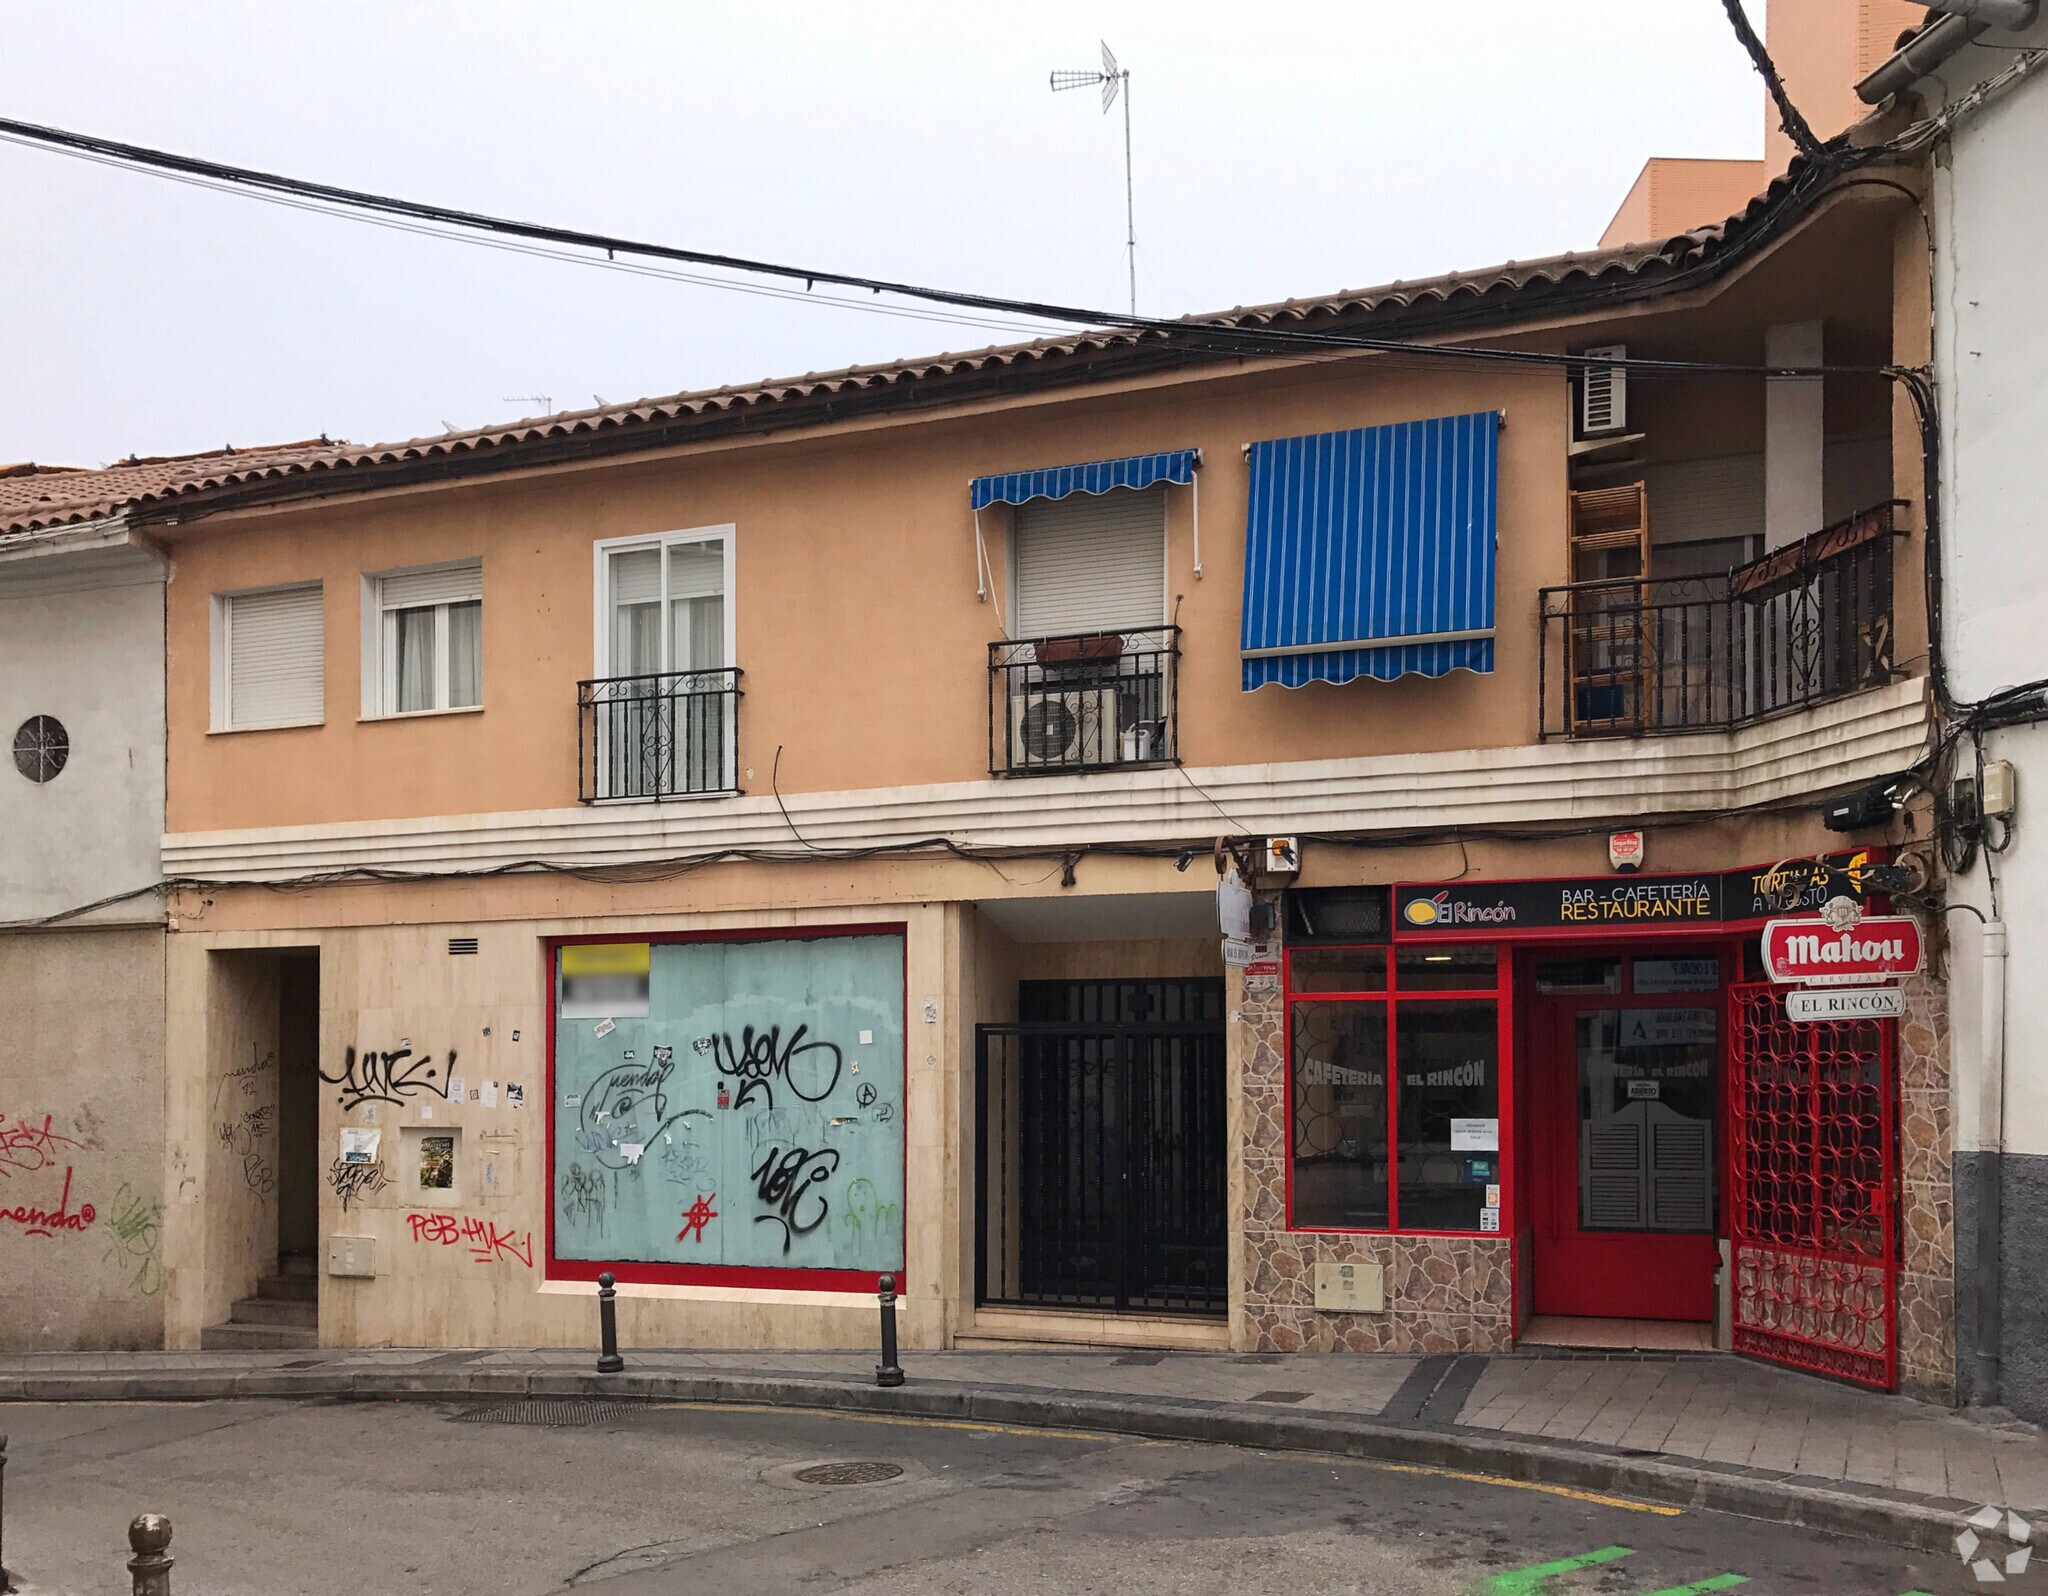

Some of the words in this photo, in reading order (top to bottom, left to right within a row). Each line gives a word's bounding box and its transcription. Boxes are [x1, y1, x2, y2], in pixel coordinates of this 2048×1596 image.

[1562, 889, 1595, 903] BAR
[1611, 880, 1711, 901] CAFETERÍA
[1436, 902, 1453, 924] El
[1454, 900, 1517, 924] Rincón
[1561, 897, 1711, 920] RESTAURANTE
[1752, 896, 1763, 913] A
[1785, 933, 1905, 965] Mahou
[1809, 974, 1882, 984] CERVEZAS
[1801, 999, 1822, 1013] EL
[1828, 992, 1894, 1011] RINCÓN
[1304, 1058, 1383, 1087] CAFETERÍA
[1407, 1073, 1425, 1087] EL
[1427, 1059, 1485, 1088] RINCÓN
[1631, 1087, 1657, 1095] ABIERTO
